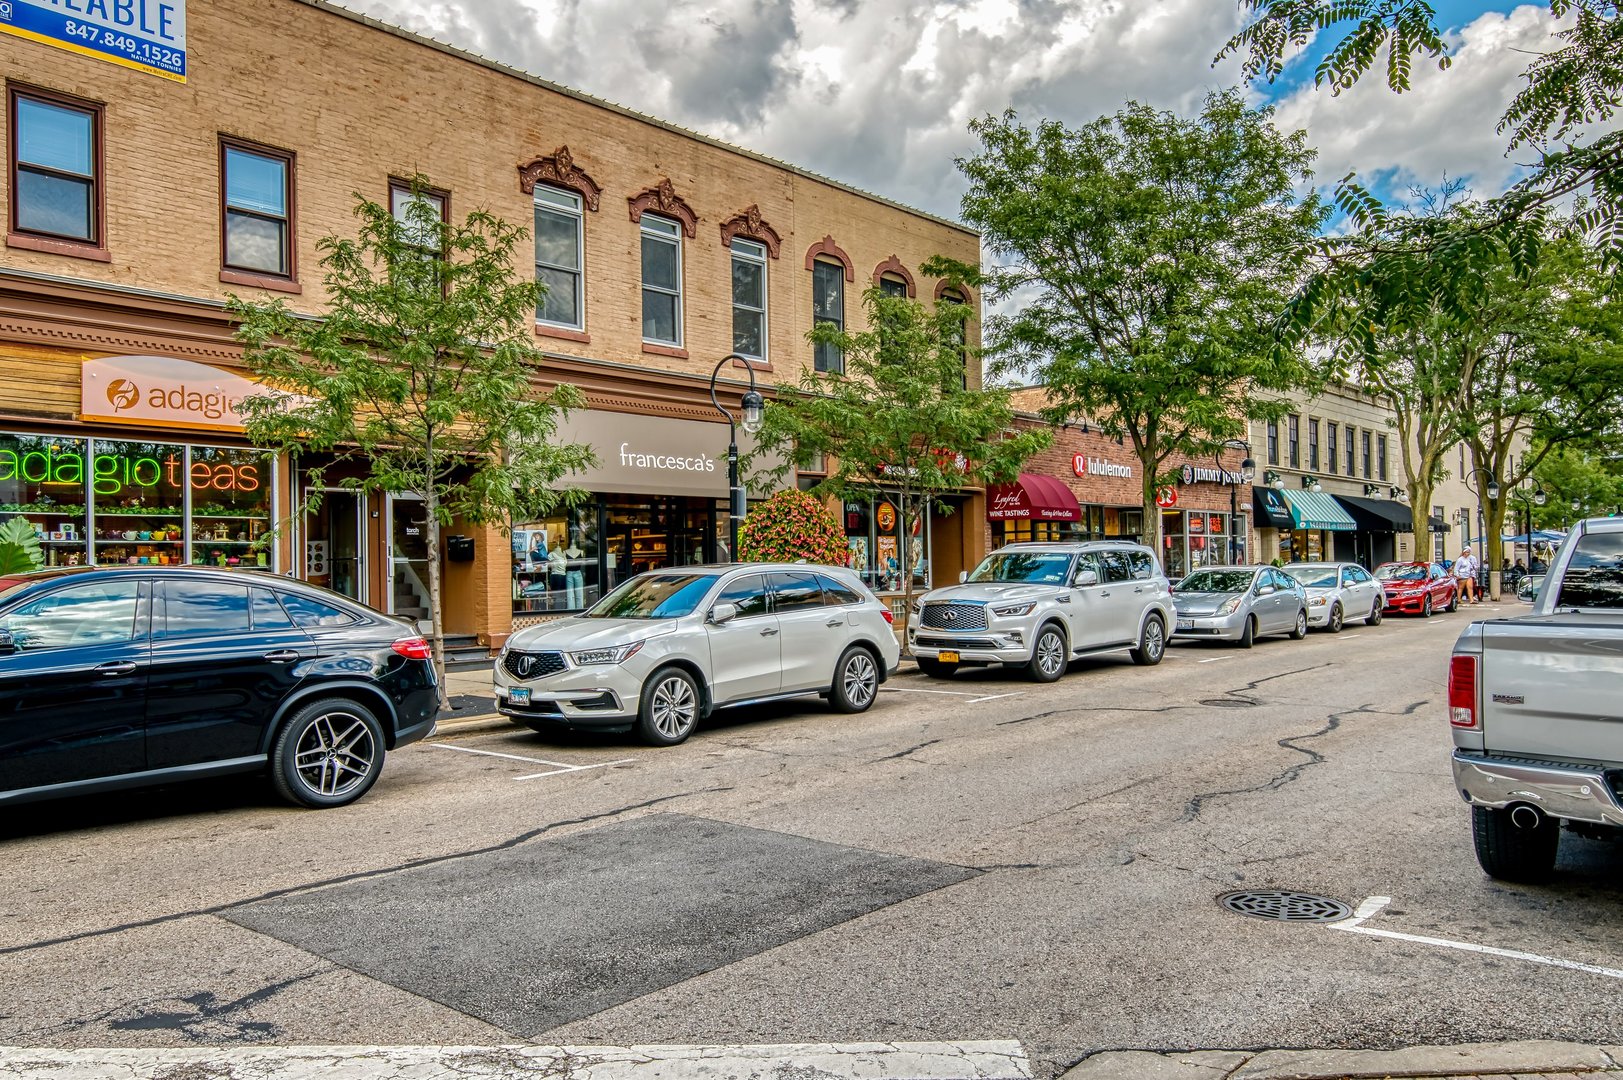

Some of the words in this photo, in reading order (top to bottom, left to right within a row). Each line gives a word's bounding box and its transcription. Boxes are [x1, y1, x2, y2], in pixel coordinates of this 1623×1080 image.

[52, 0, 175, 41] ABLE
[65, 20, 182, 67] 847.849.1526
[130, 53, 156, 65] NATHAN
[157, 61, 182, 73] TONNIES
[0, 445, 161, 494] adagio
[164, 453, 259, 491] teas
[619, 442, 715, 472] francesca's
[1087, 457, 1132, 478] lululemon
[1193, 467, 1221, 483] JIMMY
[1222, 471, 1248, 485] JOHN
[1004, 509, 1030, 517] TASTINGS
